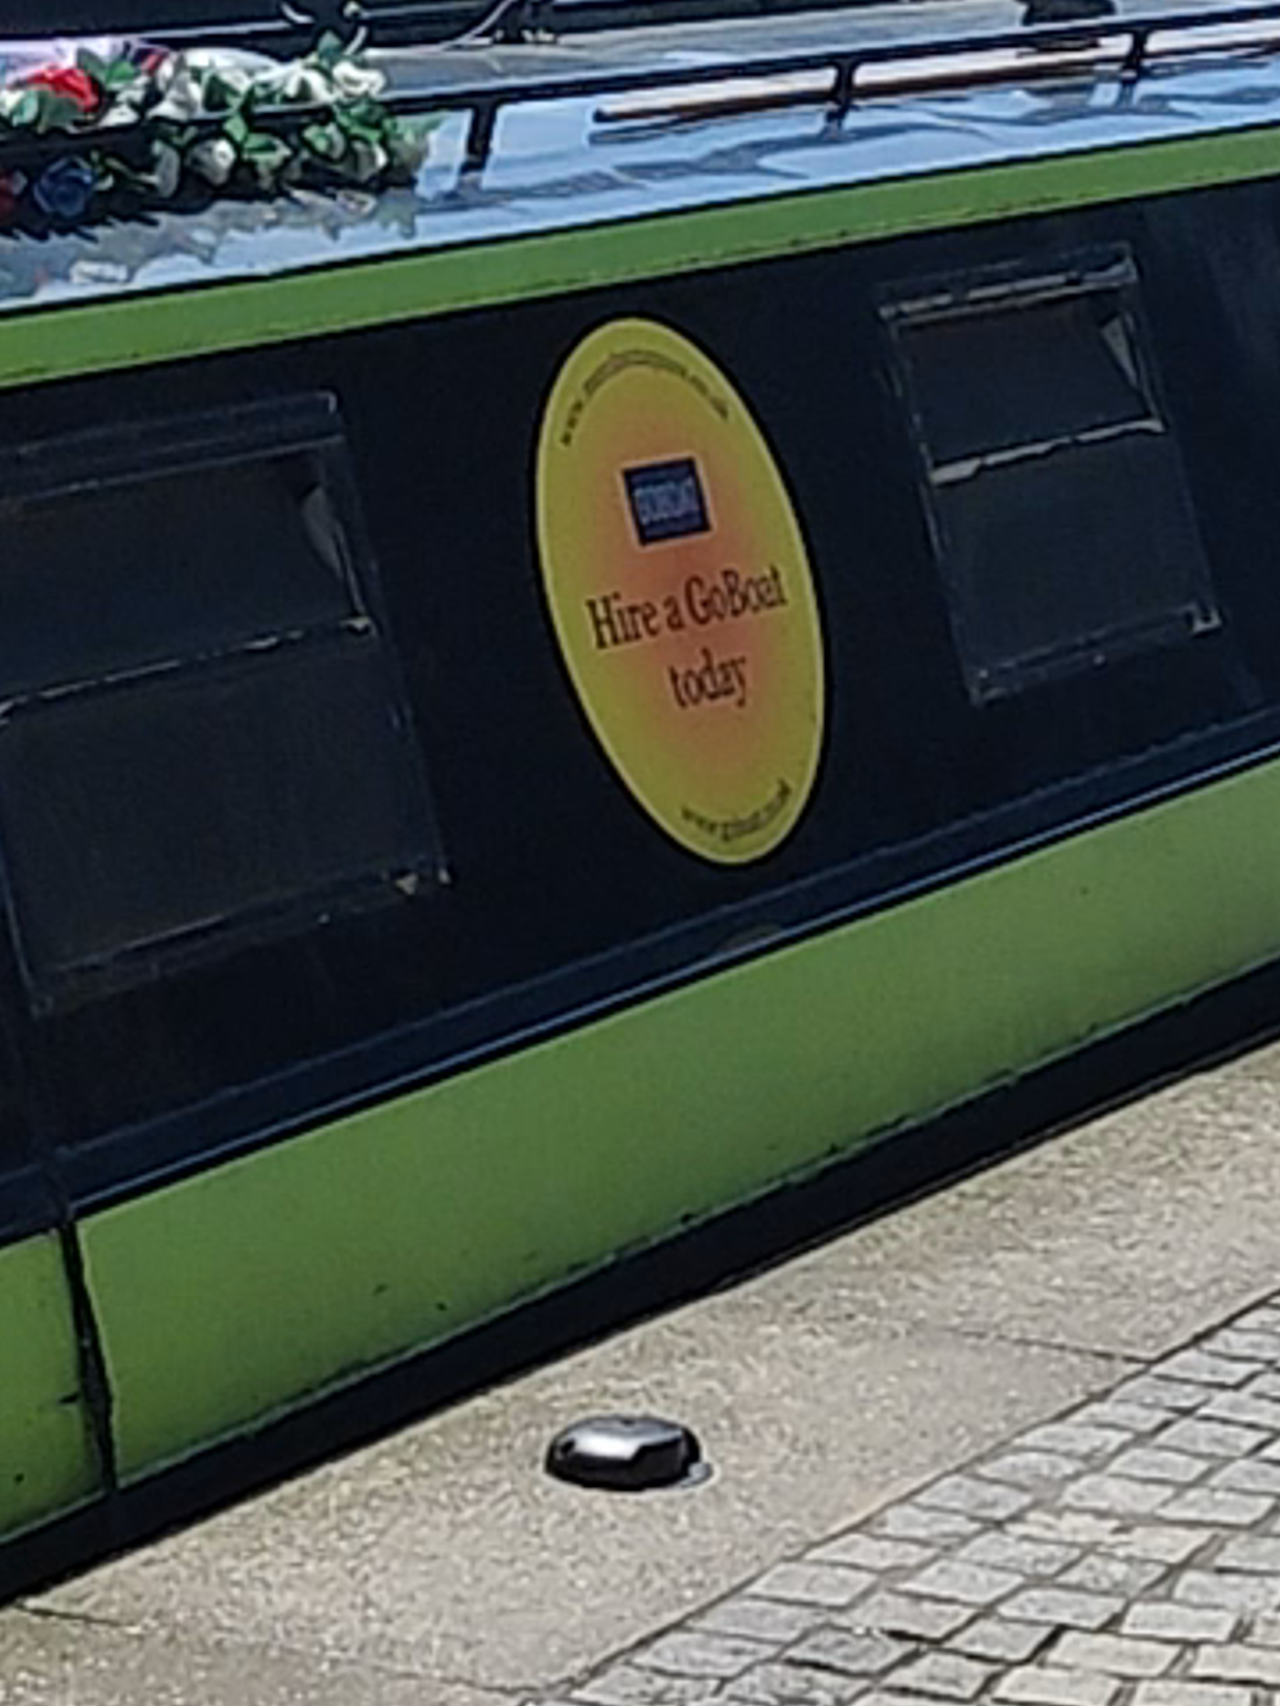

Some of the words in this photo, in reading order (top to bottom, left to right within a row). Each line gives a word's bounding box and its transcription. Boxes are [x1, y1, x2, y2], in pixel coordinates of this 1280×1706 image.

[586, 591, 660, 649] Hire
[665, 597, 683, 632] a
[684, 564, 787, 625] GoBoat
[668, 647, 747, 708] today
